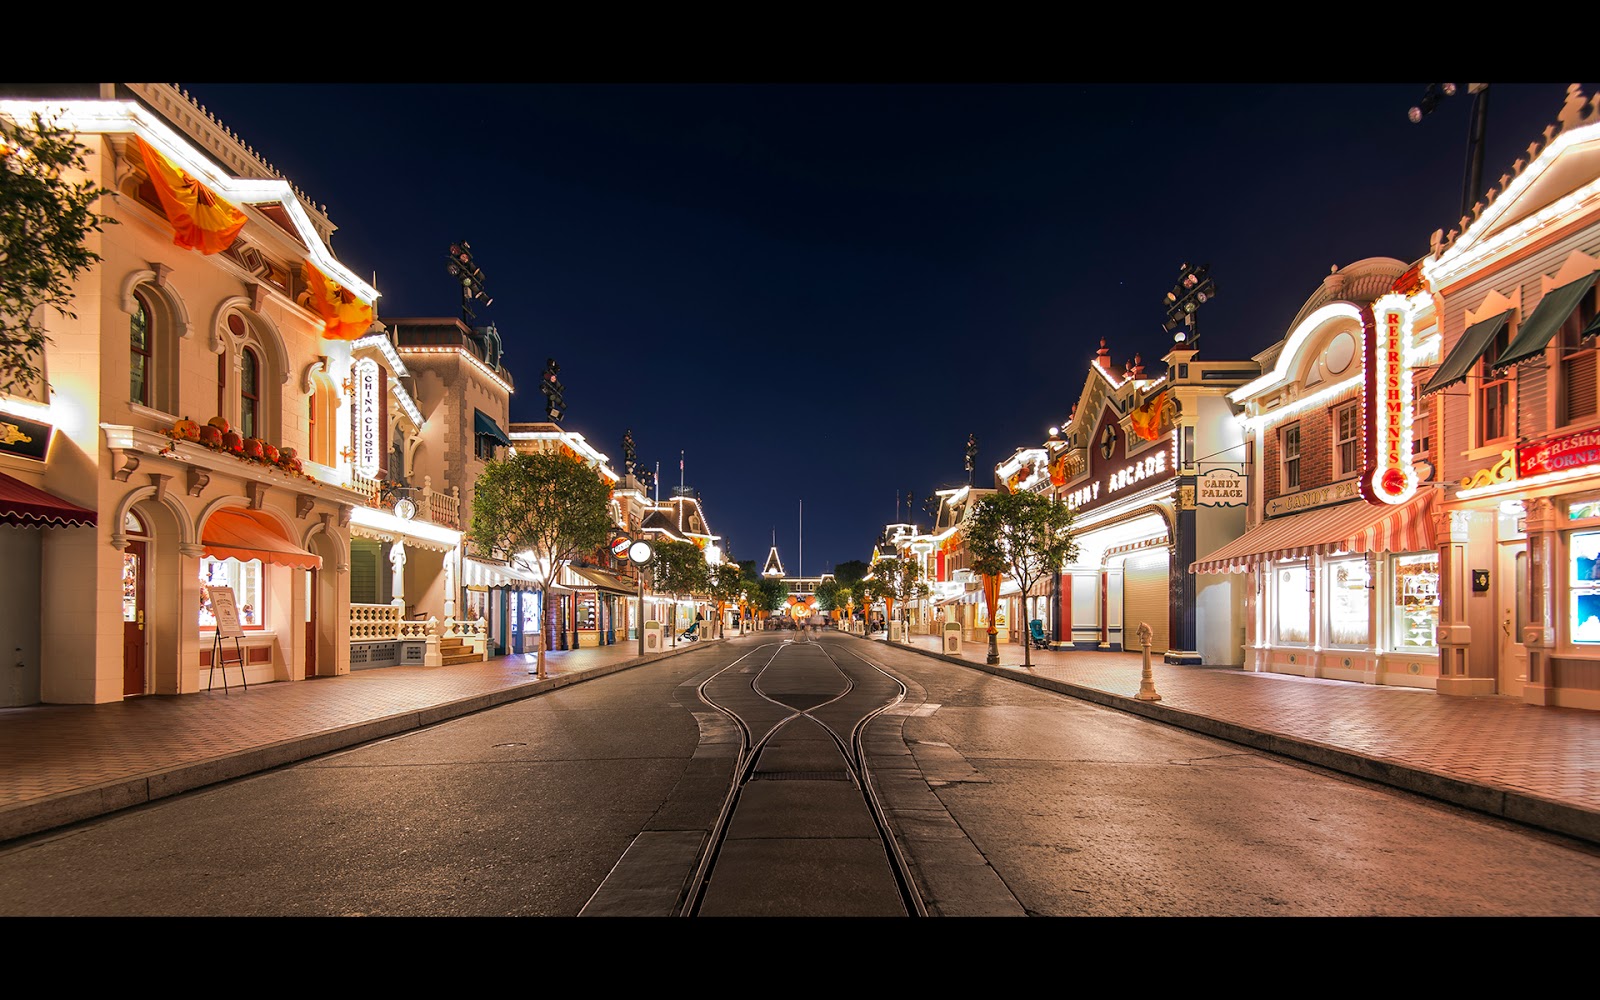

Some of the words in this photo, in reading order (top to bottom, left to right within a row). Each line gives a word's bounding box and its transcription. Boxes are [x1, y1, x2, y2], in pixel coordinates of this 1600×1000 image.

[364, 375, 373, 413] CHINA
[1387, 313, 1401, 464] REFRESHMENTS
[364, 417, 373, 463] CLOSET
[1108, 450, 1166, 494] ARCADE
[1544, 448, 1600, 471] CORNE
[1201, 489, 1243, 498] PALACE
[1203, 480, 1241, 488] CANDY
[1285, 488, 1330, 511] CANDY
